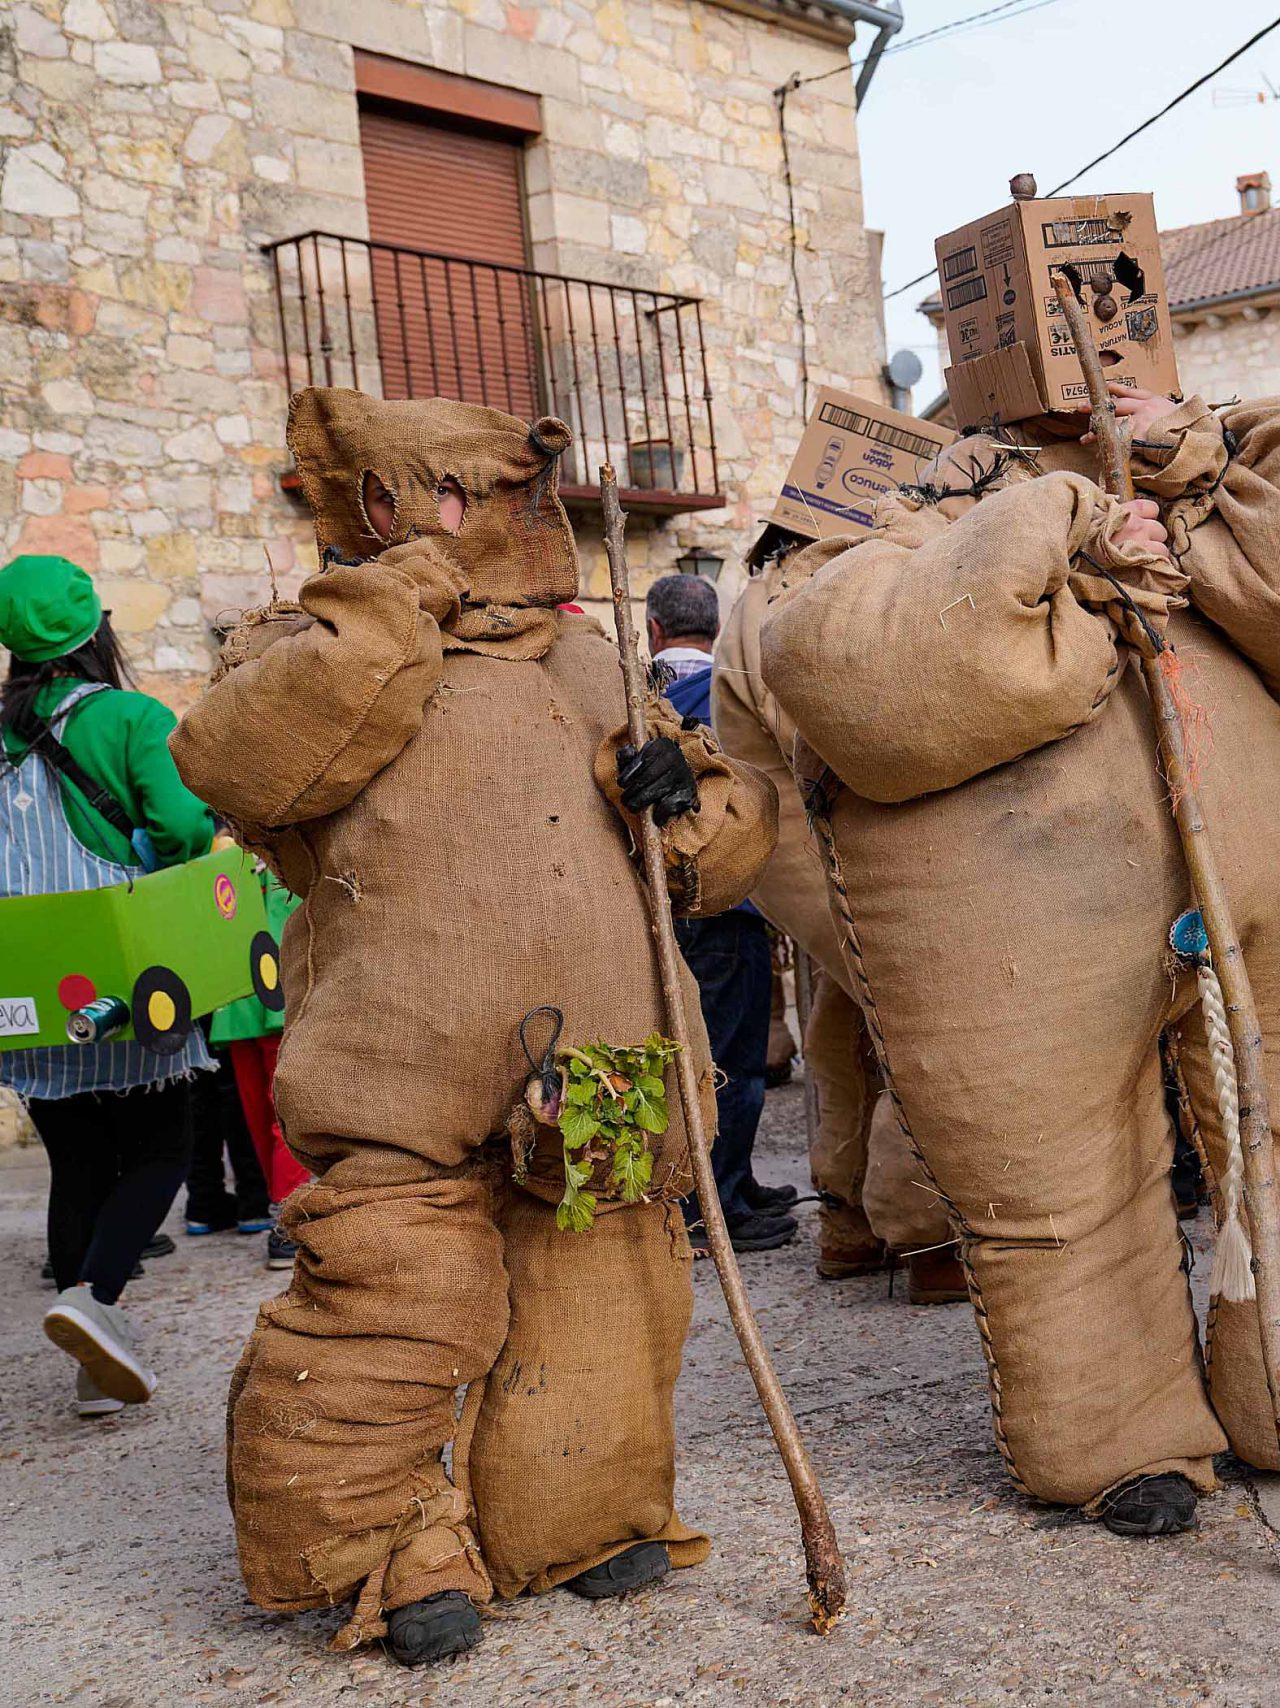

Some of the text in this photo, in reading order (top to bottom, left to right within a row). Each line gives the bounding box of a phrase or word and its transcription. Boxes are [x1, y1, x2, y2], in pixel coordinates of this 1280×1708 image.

[1098, 320, 1123, 333] ACQUA
[1099, 334, 1127, 350] NATURA
[1051, 346, 1077, 357] ATIS
[1065, 385, 1089, 397] 9574
[862, 452, 895, 471] Jabón
[849, 474, 890, 495] enuco
